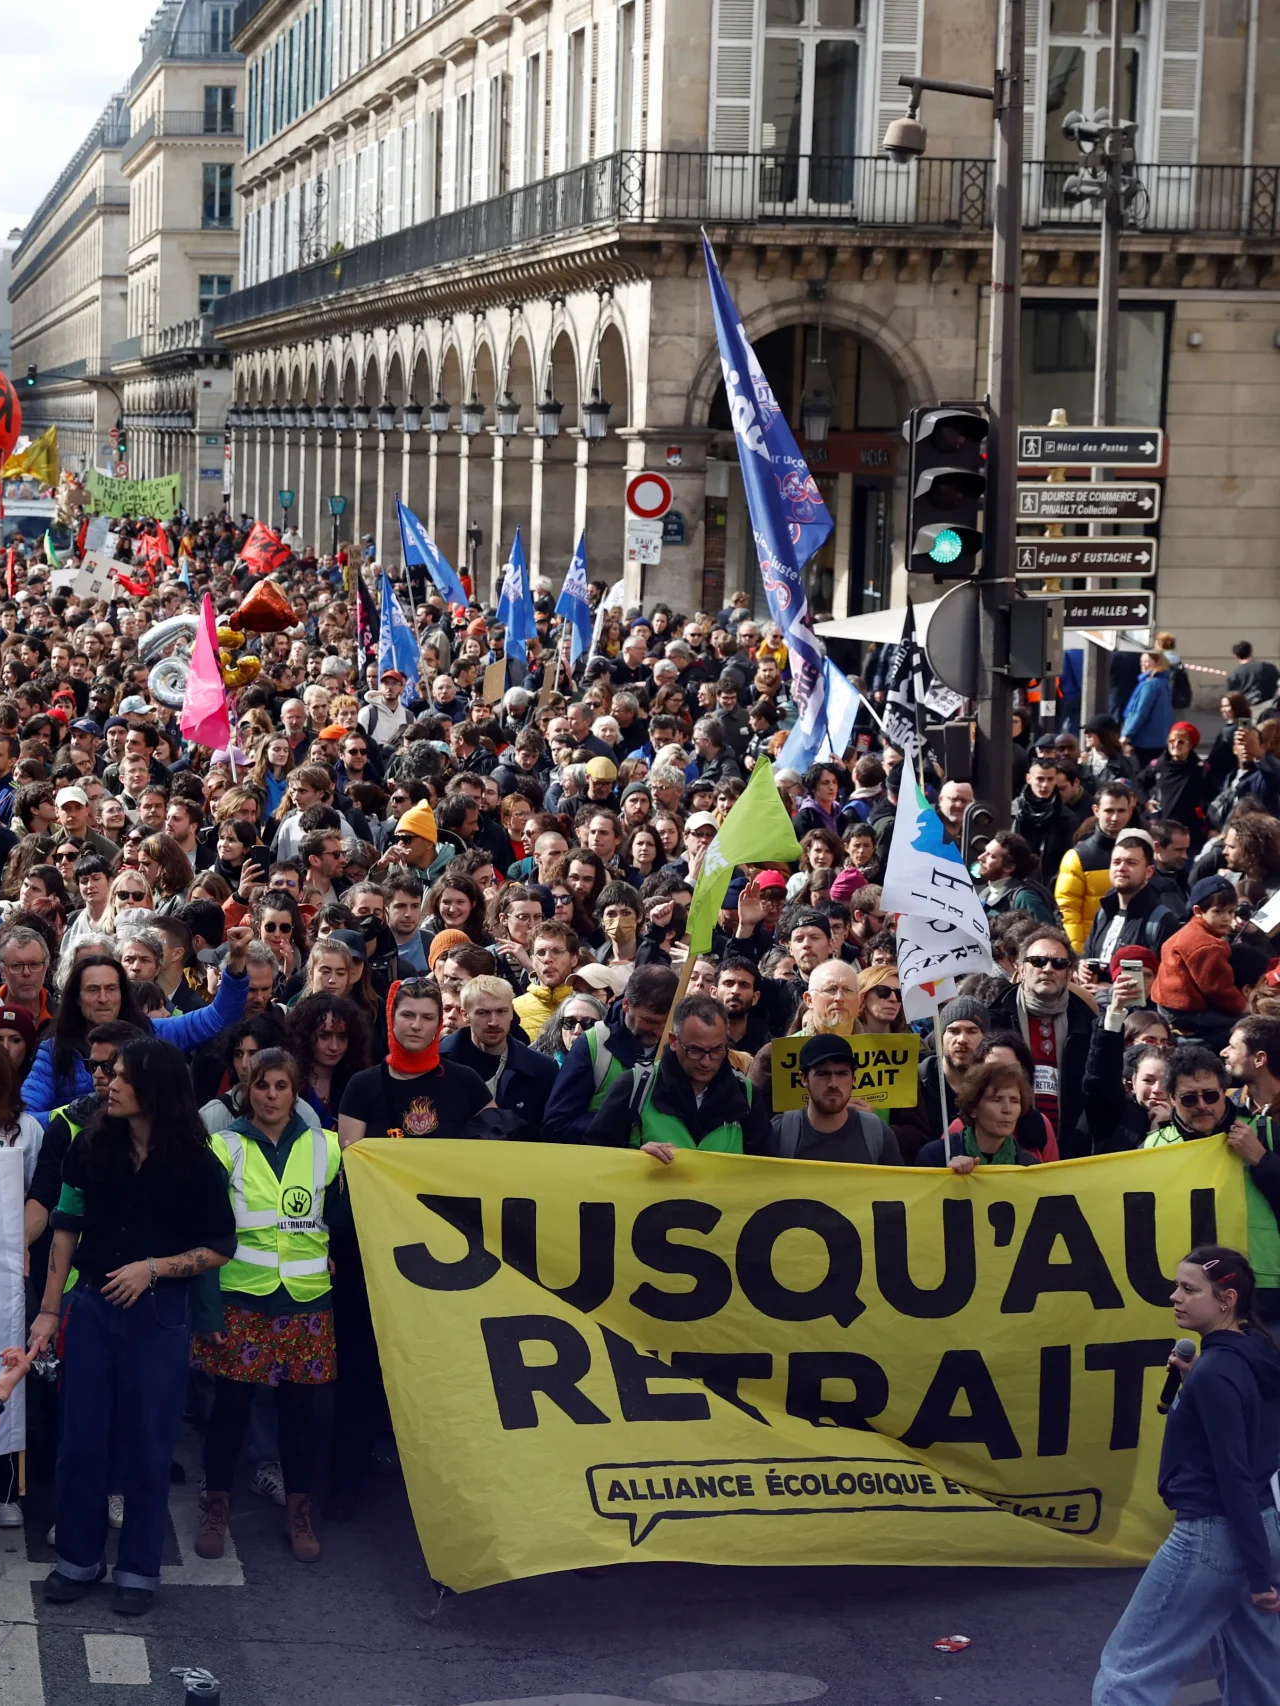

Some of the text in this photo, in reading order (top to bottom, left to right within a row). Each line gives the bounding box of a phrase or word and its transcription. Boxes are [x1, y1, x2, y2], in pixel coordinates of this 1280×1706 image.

[1056, 442, 1129, 453] Hôtel des Postes
[1040, 491, 1138, 503] BOURSE DE COMMERCE
[94, 498, 115, 513] EN
[1040, 504, 1118, 516] PINAULT Collection
[635, 537, 654, 546] SAUF
[1038, 550, 1068, 566] Église
[1083, 552, 1133, 563] EUSTACHE
[1071, 606, 1088, 616] des
[1091, 605, 1129, 617] HALLES
[780, 1050, 909, 1069] JU'AU
[790, 1069, 900, 1090] RAIT
[393, 1187, 1219, 1329] JUSQU'AU
[606, 1473, 755, 1503] ALLIANCE
[765, 1466, 937, 1497] ÉCOLOGIQUE
